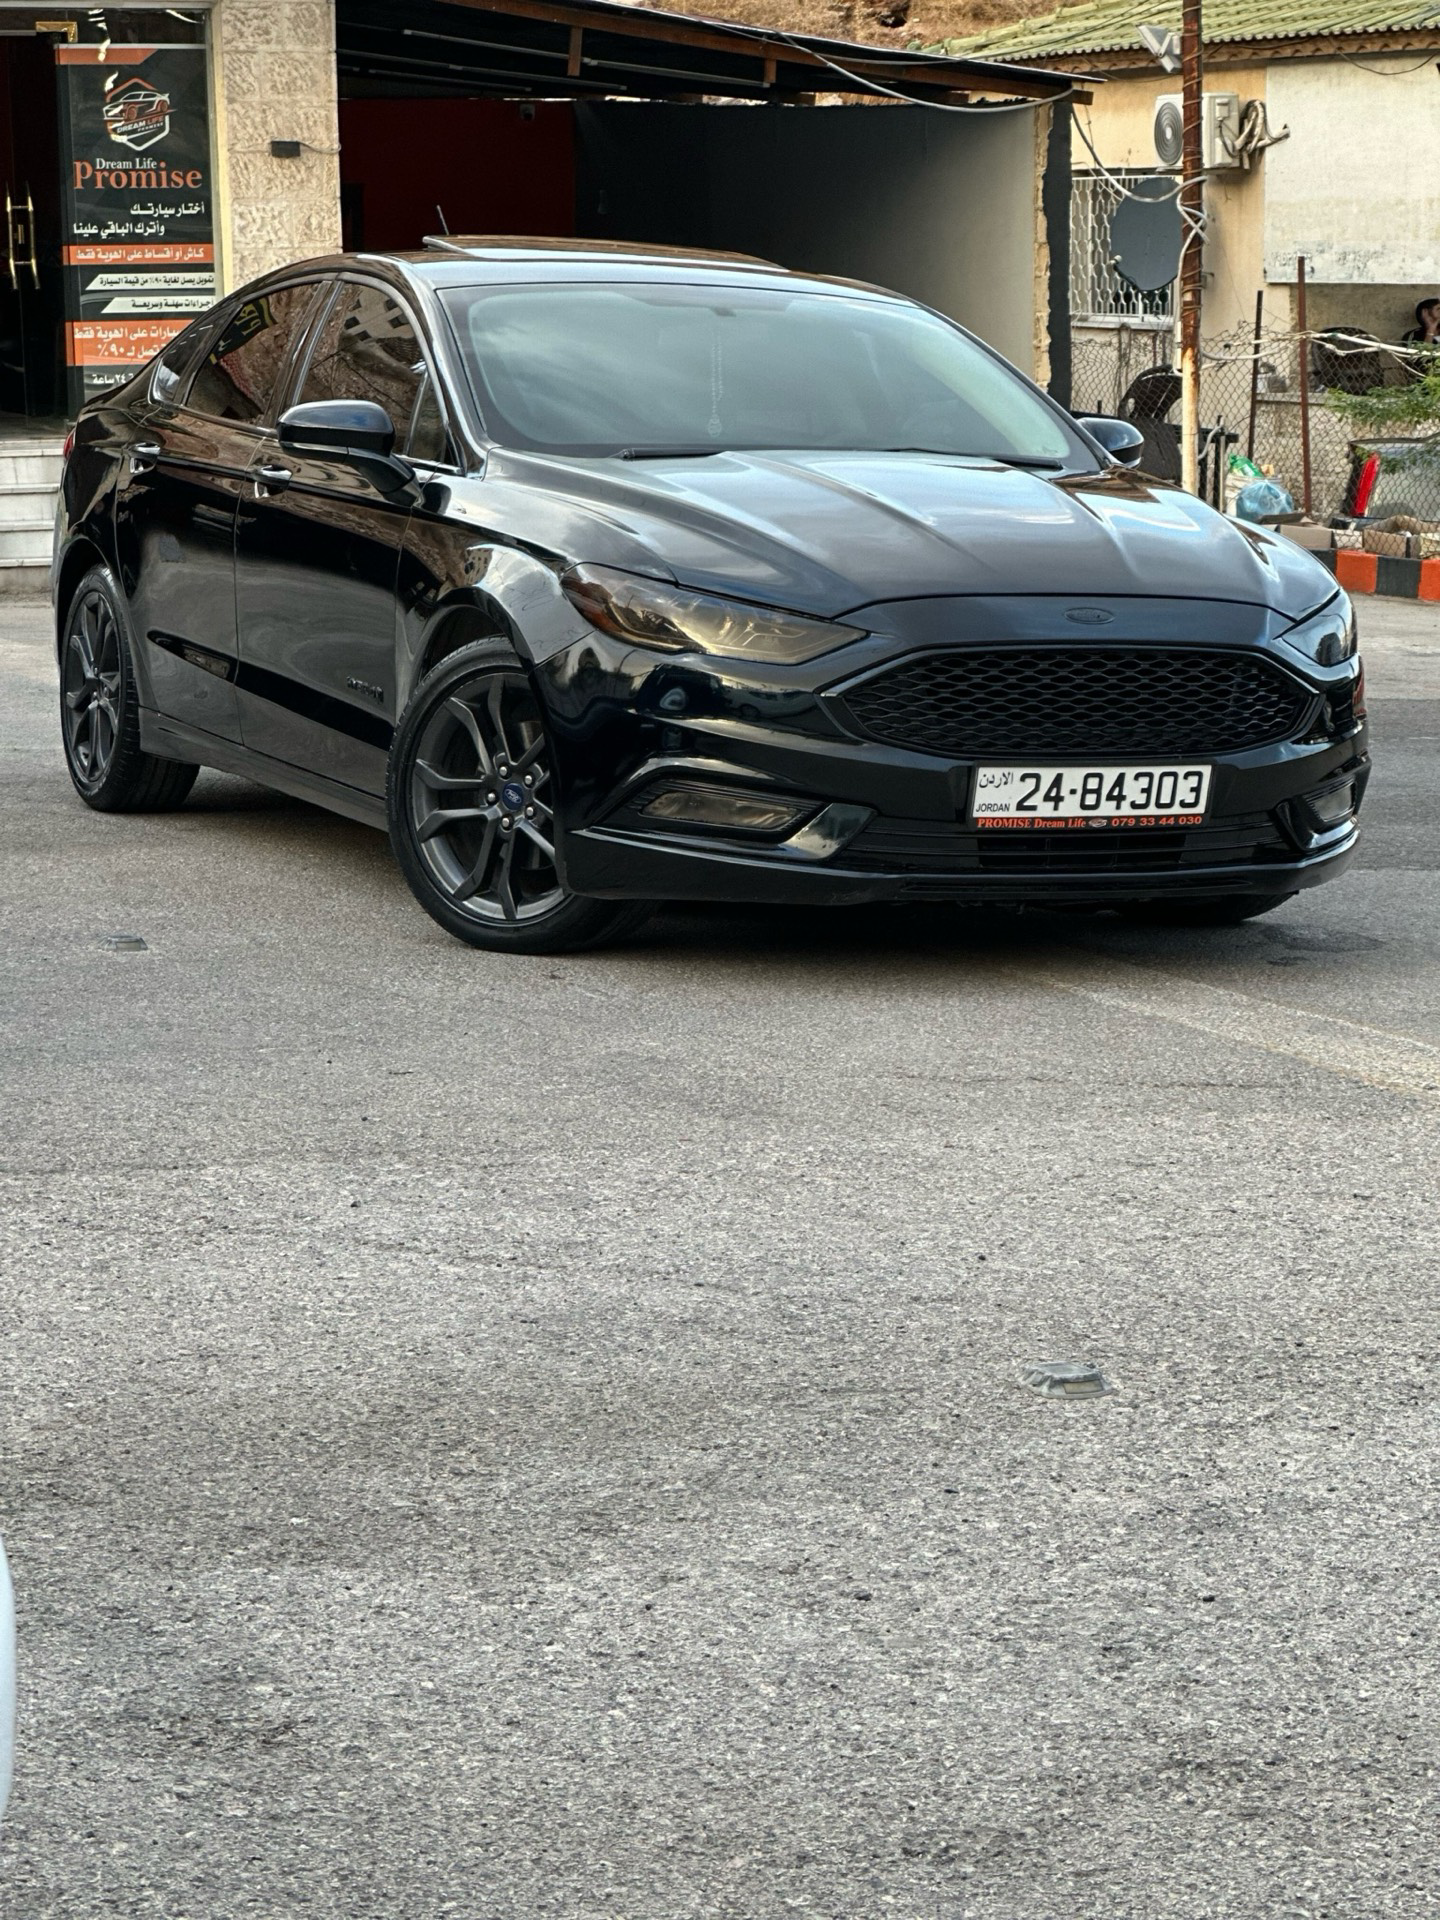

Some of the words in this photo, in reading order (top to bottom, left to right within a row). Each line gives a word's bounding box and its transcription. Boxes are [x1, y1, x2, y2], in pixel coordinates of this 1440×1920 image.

[117, 120, 146, 134] DREAM
[96, 158, 132, 169] Dream
[135, 158, 157, 169] Life
[73, 160, 203, 189] Promise
[73, 222, 99, 237] علينا
[100, 221, 133, 239] الباقي
[134, 220, 165, 236] وأترك
[76, 248, 96, 260] فقط
[97, 248, 126, 263] الهوية
[127, 249, 143, 262] على
[144, 247, 174, 260] أقساط
[174, 247, 183, 261] أو
[184, 247, 205, 261] كاش
[99, 277, 124, 287] السيارة
[124, 276, 139, 287] قيمة
[73, 327, 95, 339] فقط
[96, 325, 128, 342] الهوية
[129, 327, 148, 340] على
[92, 373, 115, 384] ساعة
[1015, 770, 1203, 812] 24-84303
[975, 803, 1010, 813] JORDAN
[977, 817, 1032, 829] PROMISE
[1033, 817, 1066, 829] Dream
[1068, 816, 1087, 828] Life
[1111, 817, 1136, 827] 079
[1139, 817, 1156, 826] 33
[1159, 816, 1175, 826] 44
[1179, 815, 1203, 825] 030
